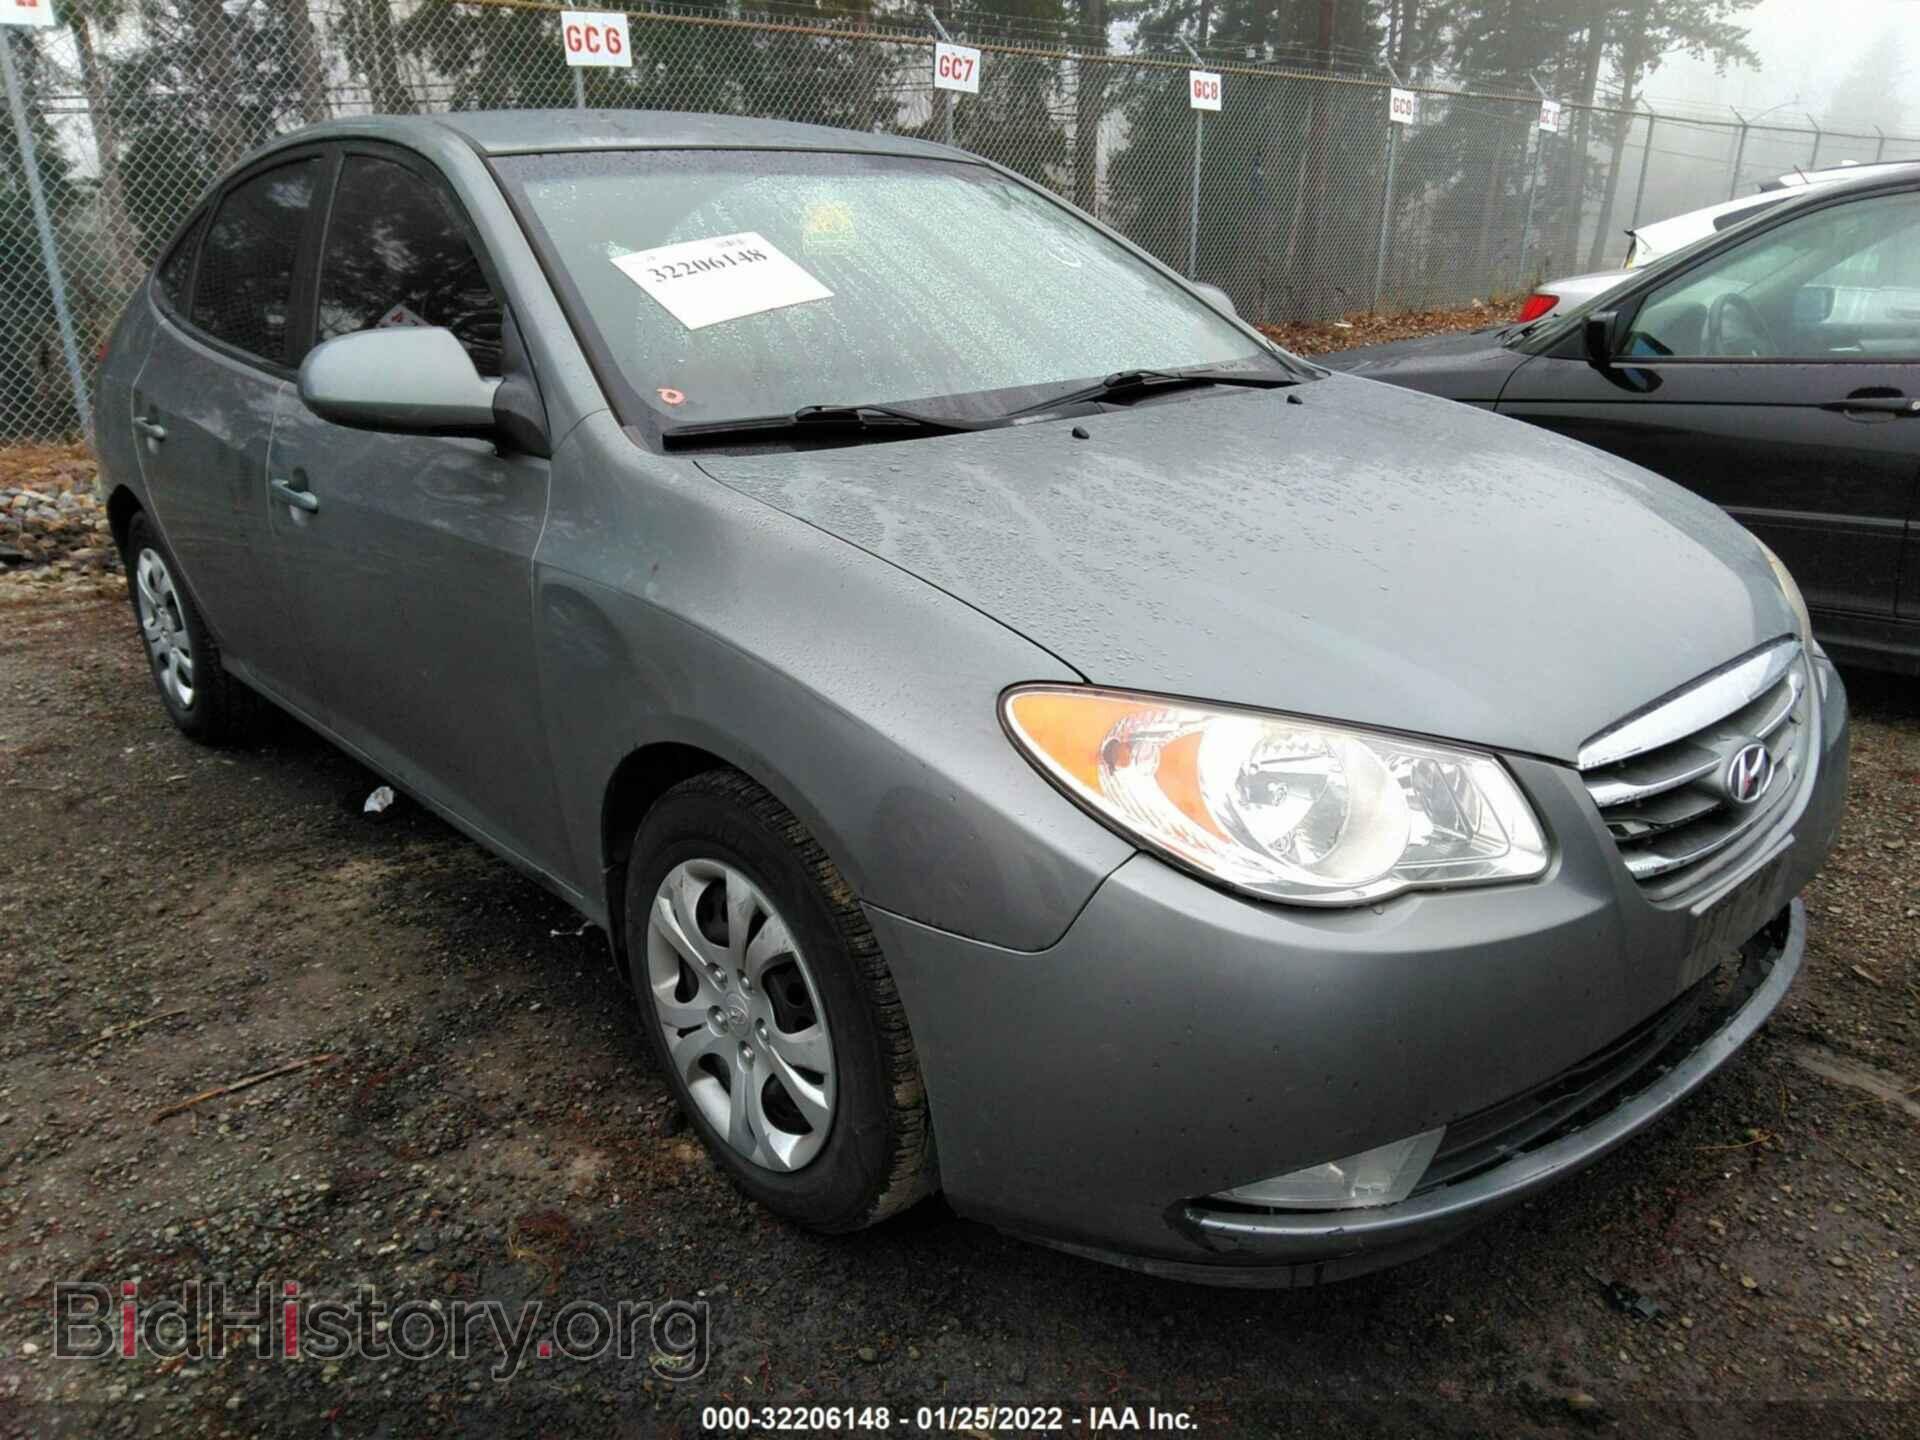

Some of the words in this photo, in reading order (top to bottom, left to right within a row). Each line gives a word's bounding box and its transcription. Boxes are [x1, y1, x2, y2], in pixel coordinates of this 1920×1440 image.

[566, 25, 622, 55] GC6
[939, 54, 974, 82] GC7
[1194, 79, 1218, 100] GC8
[648, 248, 768, 283] 32206148
